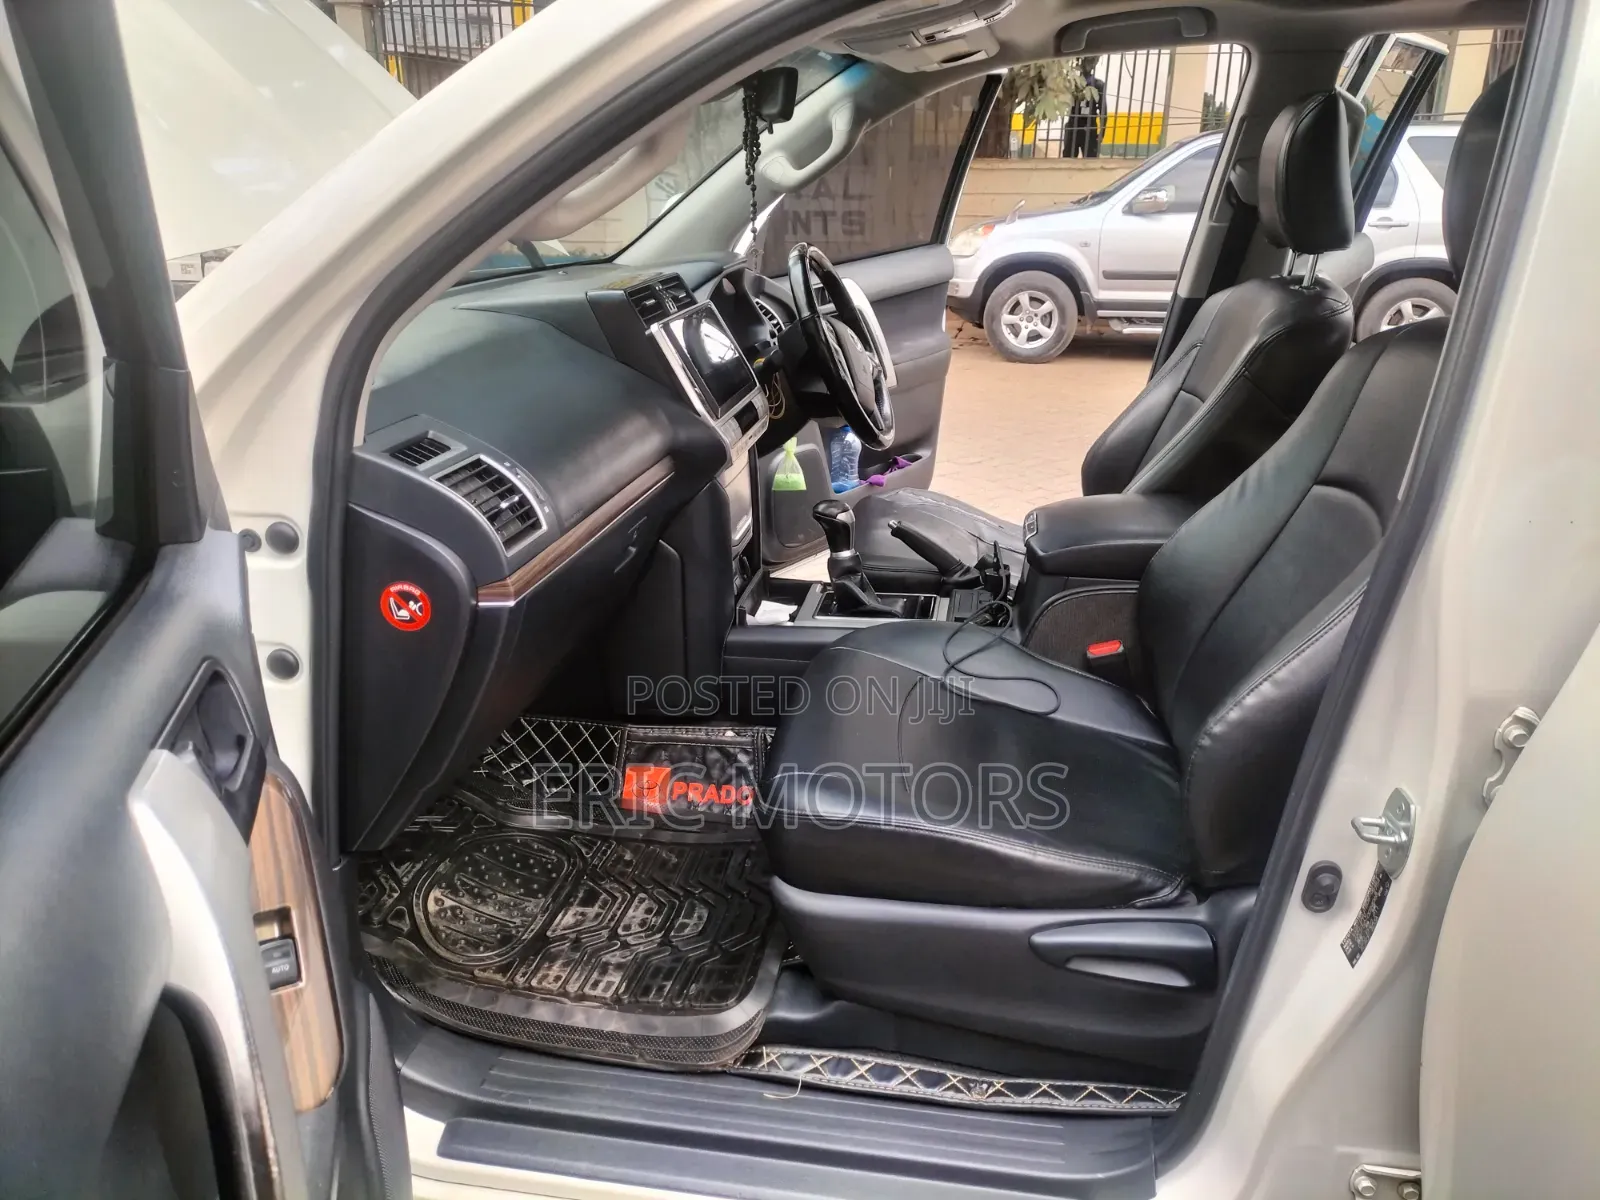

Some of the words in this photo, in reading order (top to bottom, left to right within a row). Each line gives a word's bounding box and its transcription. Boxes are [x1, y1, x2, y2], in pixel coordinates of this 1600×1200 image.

[797, 170, 869, 200] AL
[784, 210, 866, 236] NTS
[390, 584, 421, 596] AIRBAG
[671, 781, 756, 806] PRADO
[271, 963, 290, 974] AUTO
